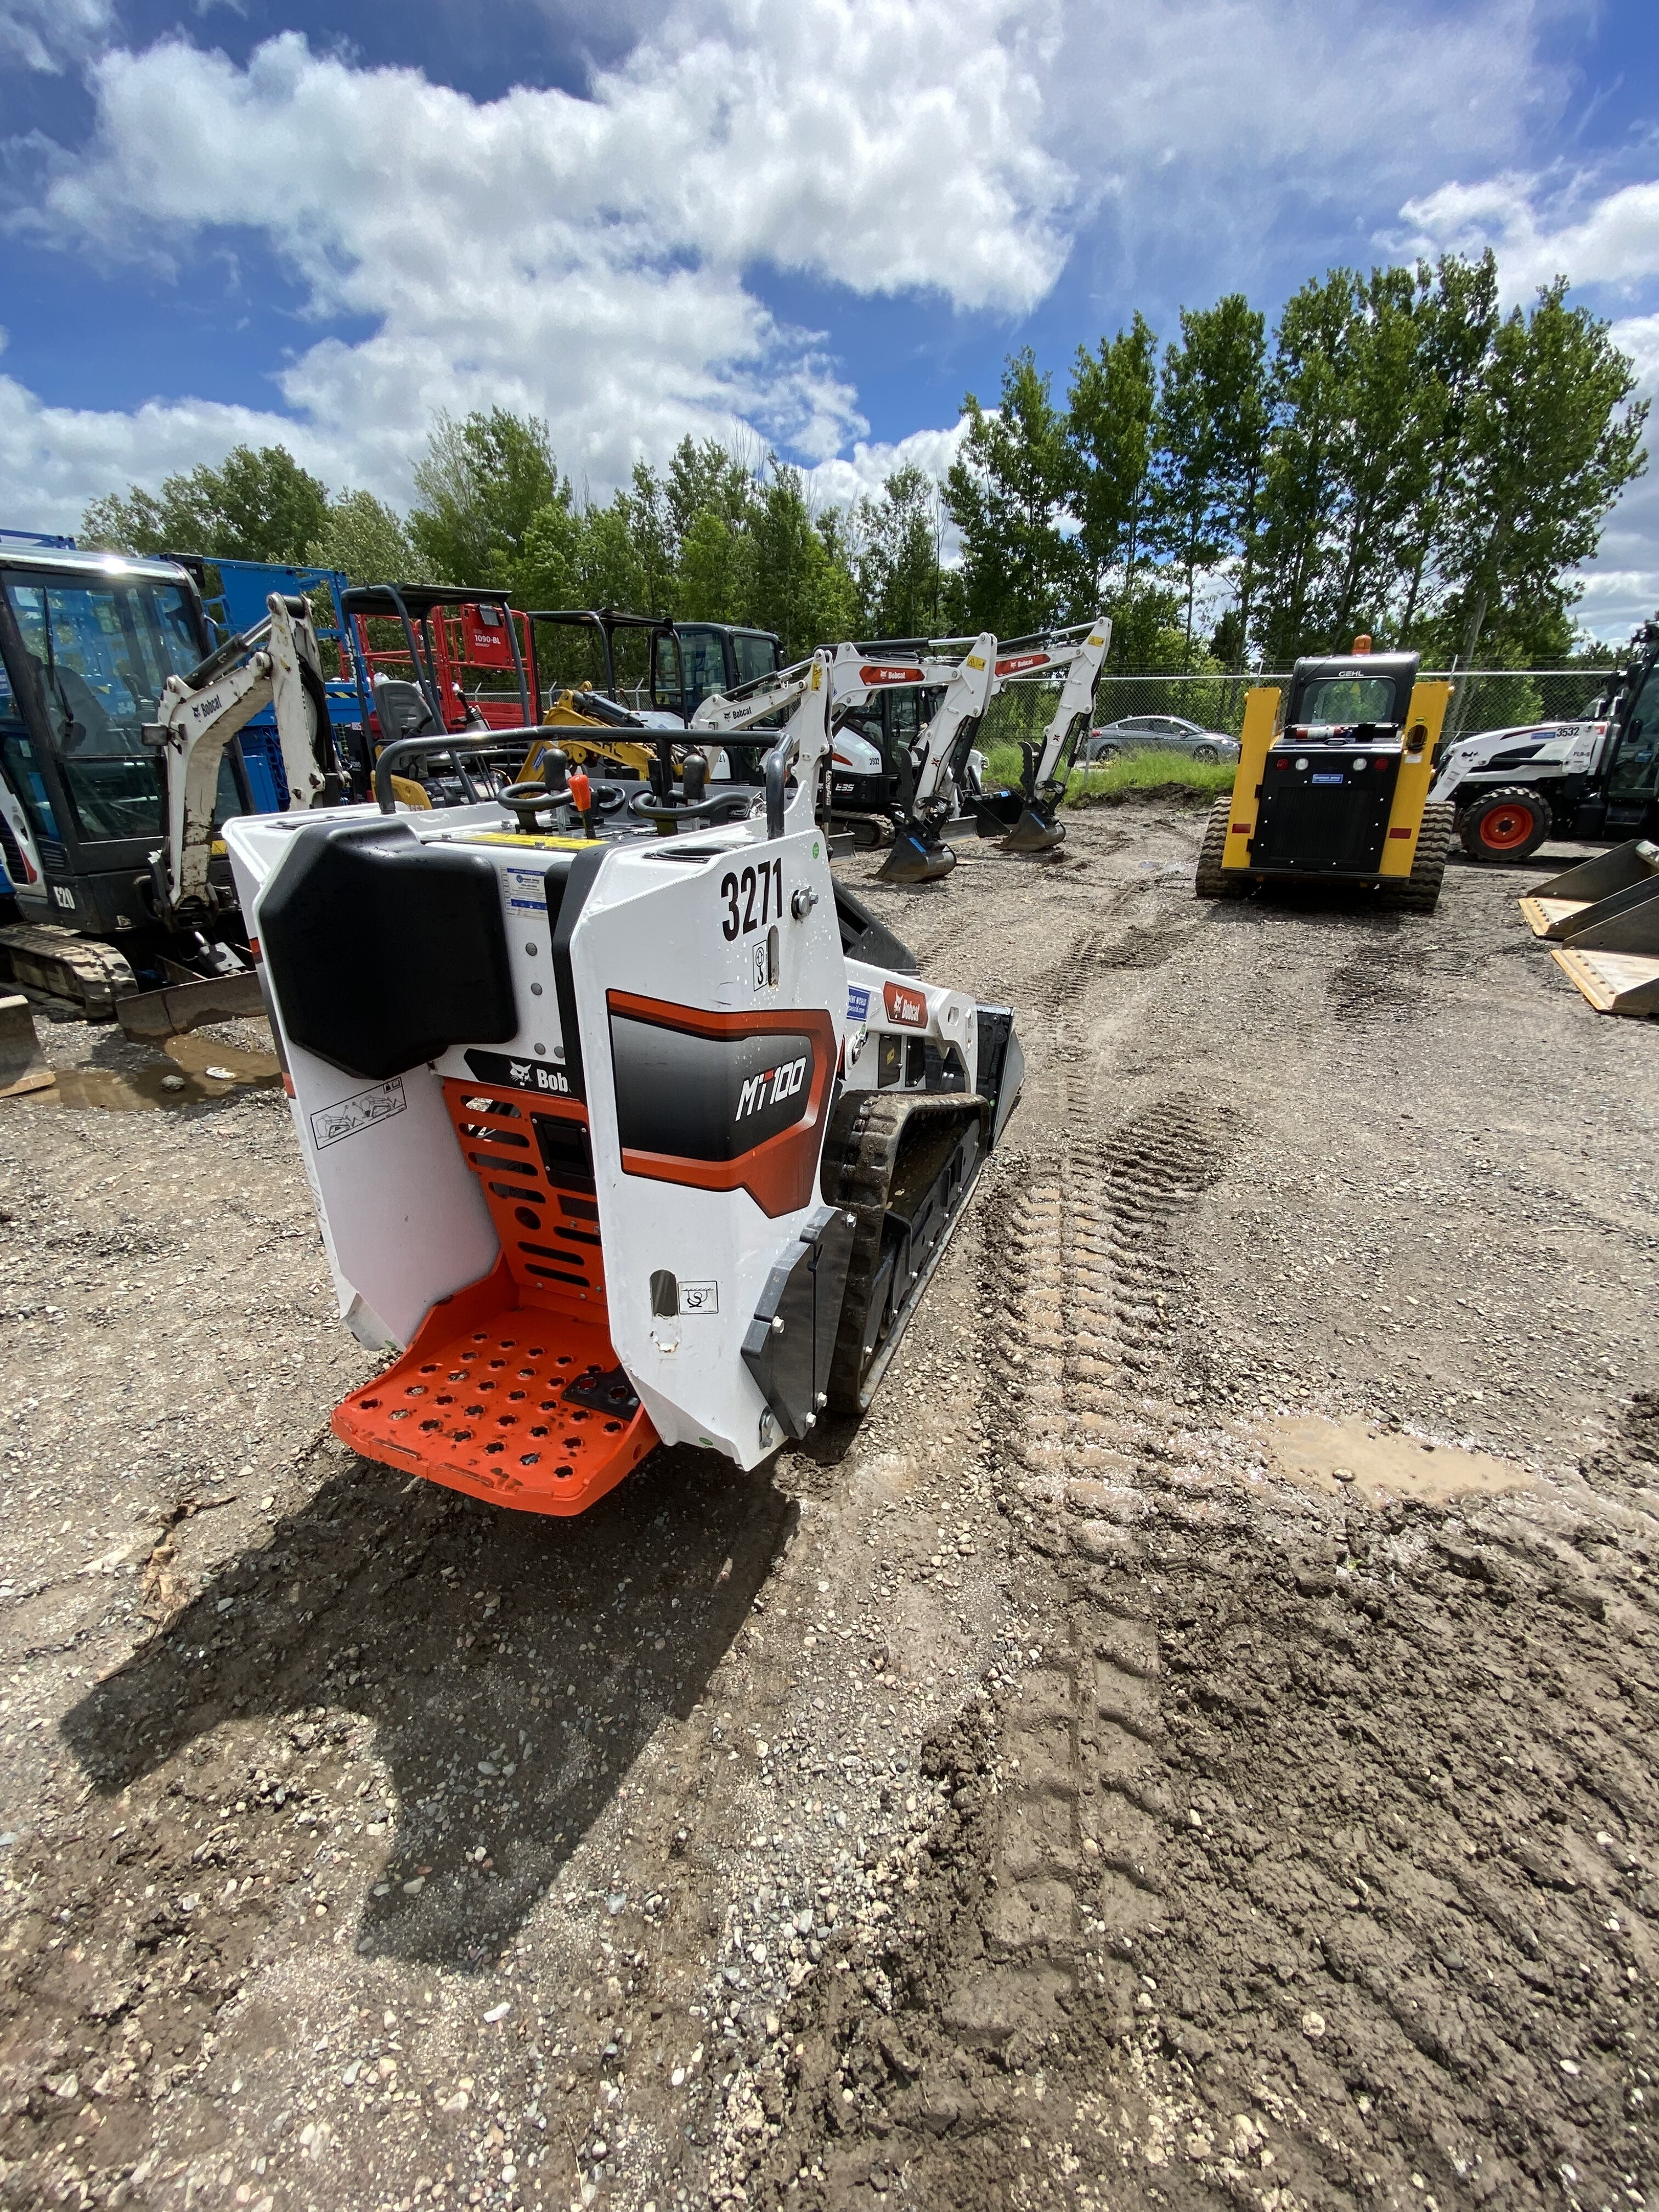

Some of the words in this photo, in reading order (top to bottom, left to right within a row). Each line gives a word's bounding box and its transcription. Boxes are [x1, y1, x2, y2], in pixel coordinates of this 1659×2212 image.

[475, 635, 501, 644] 1090-BL
[1017, 658, 1034, 668] Bobcat
[201, 694, 222, 717] Bobcat
[732, 706, 752, 719] Bobcat
[1556, 727, 1579, 737] 3532
[835, 783, 855, 792] E35
[53, 886, 75, 910] E20
[721, 857, 782, 941] 3271
[901, 998, 921, 1022] Bobcat
[537, 1069, 572, 1092] Bob
